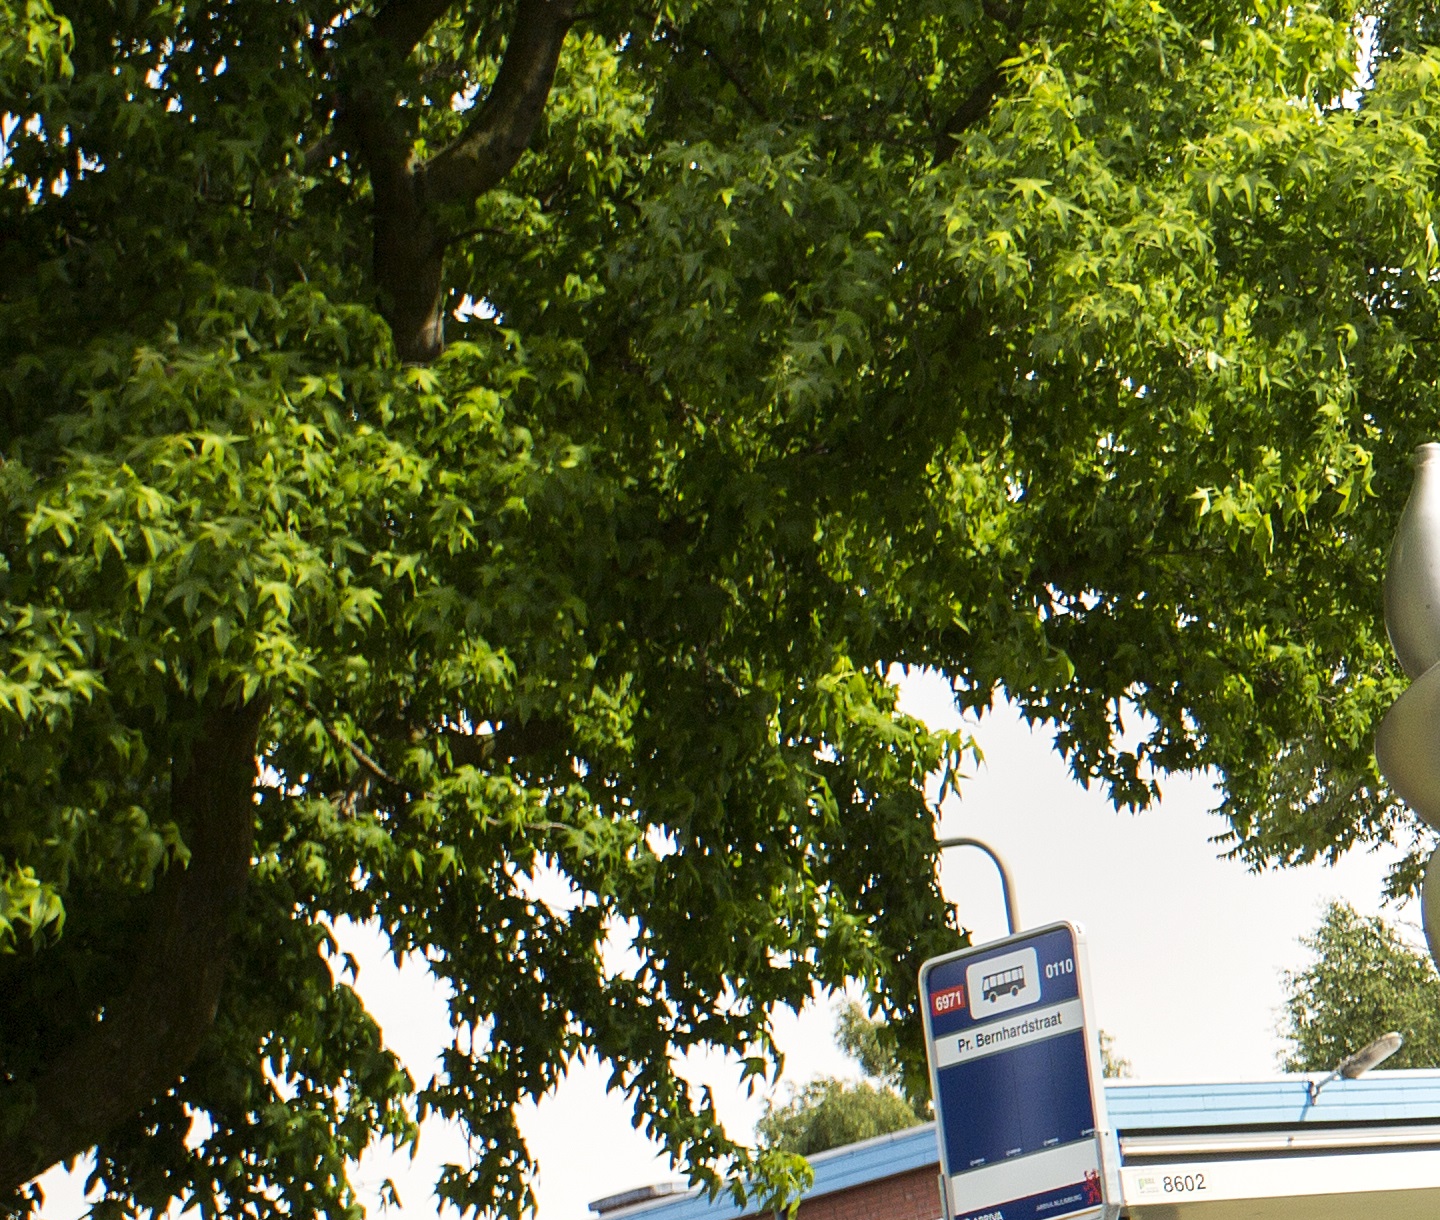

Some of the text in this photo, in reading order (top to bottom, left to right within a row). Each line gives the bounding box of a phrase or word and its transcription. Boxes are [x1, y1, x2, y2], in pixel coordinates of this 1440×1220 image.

[1045, 958, 1074, 979] 0110
[935, 990, 962, 1011] 6971
[957, 1012, 1063, 1053] Pr. Bernhardstraat
[1162, 1173, 1207, 1194] 8602
